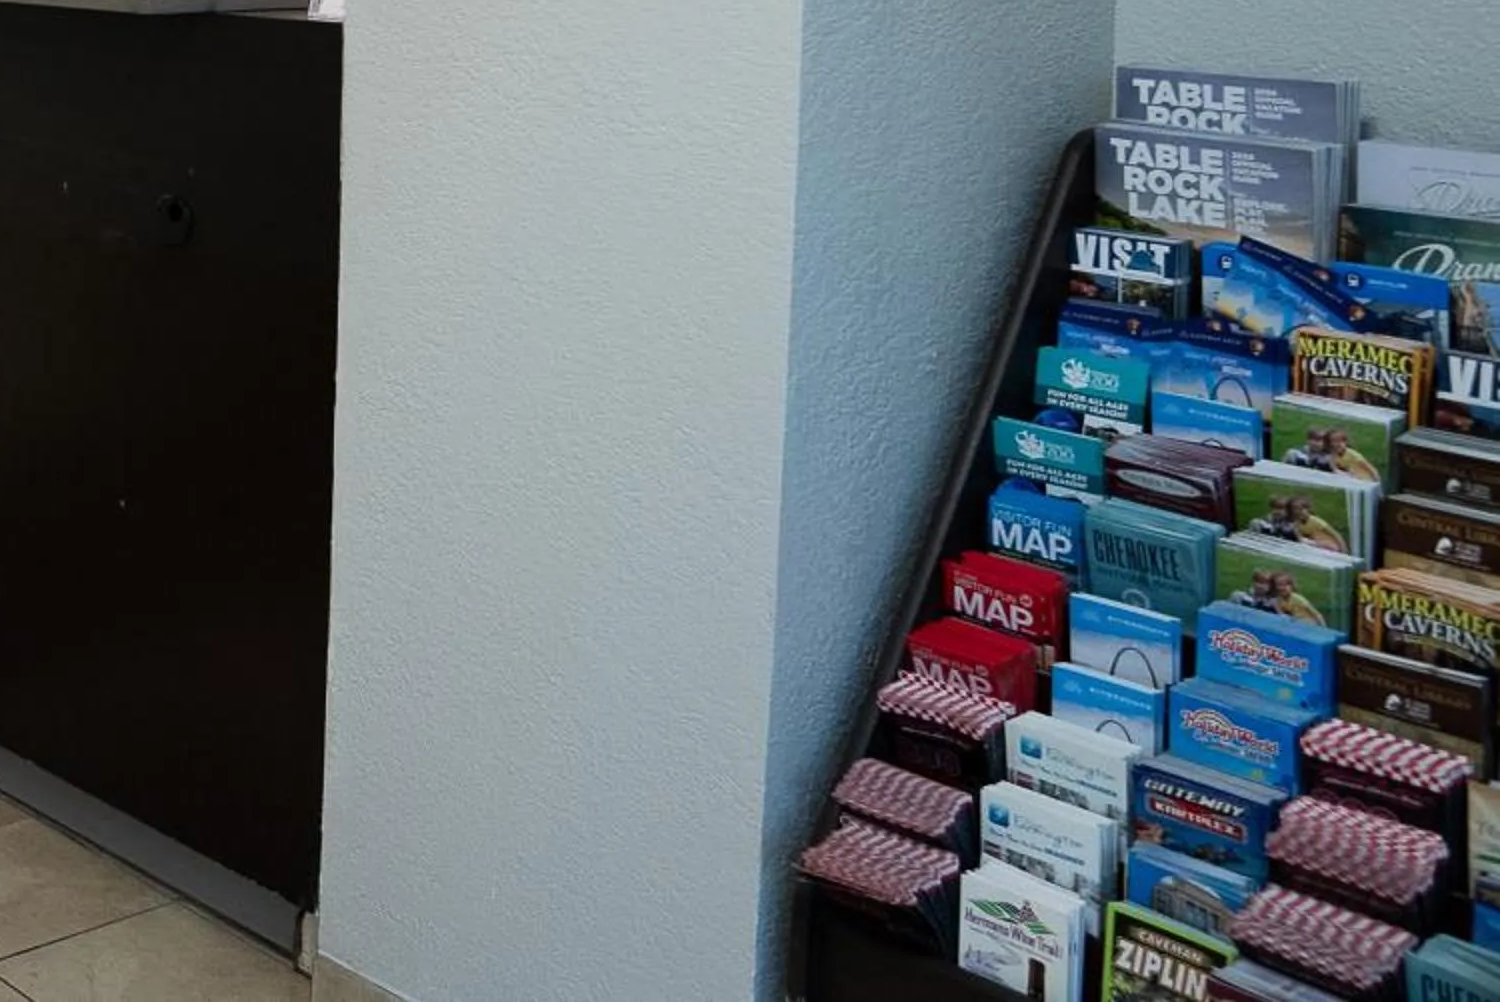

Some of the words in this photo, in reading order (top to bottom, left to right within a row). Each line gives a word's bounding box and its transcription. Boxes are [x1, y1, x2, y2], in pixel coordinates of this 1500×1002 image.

[1132, 77, 1247, 113] TABLE
[1146, 105, 1248, 135] ROCK
[1109, 137, 1224, 176] TABLE
[1123, 165, 1225, 201] ROCK
[1128, 191, 1226, 229] LAKE
[1306, 337, 1413, 376] MERAMEC
[1309, 356, 1409, 394] CAVERNS
[1047, 389, 1066, 399] FUN
[1067, 393, 1086, 403] FOR
[1088, 397, 1104, 407] ALL
[1447, 355, 1500, 402] VI
[1059, 399, 1088, 411] EVERY
[991, 517, 1073, 561] MAP
[992, 509, 1041, 527] VISITOR
[1045, 521, 1072, 537] FUN
[1092, 529, 1182, 582] CHEROKEE
[953, 585, 1035, 631] MAP
[1379, 590, 1500, 641] MERAMEC
[1384, 609, 1498, 661] CAVERNS
[912, 655, 995, 696] MAP
[1143, 778, 1246, 818] GATEWAY
[964, 905, 1010, 937] Hermann
[1011, 923, 1036, 947] Wine
[1037, 936, 1060, 958] Trail
[1116, 936, 1209, 1001] ZIPLIN
